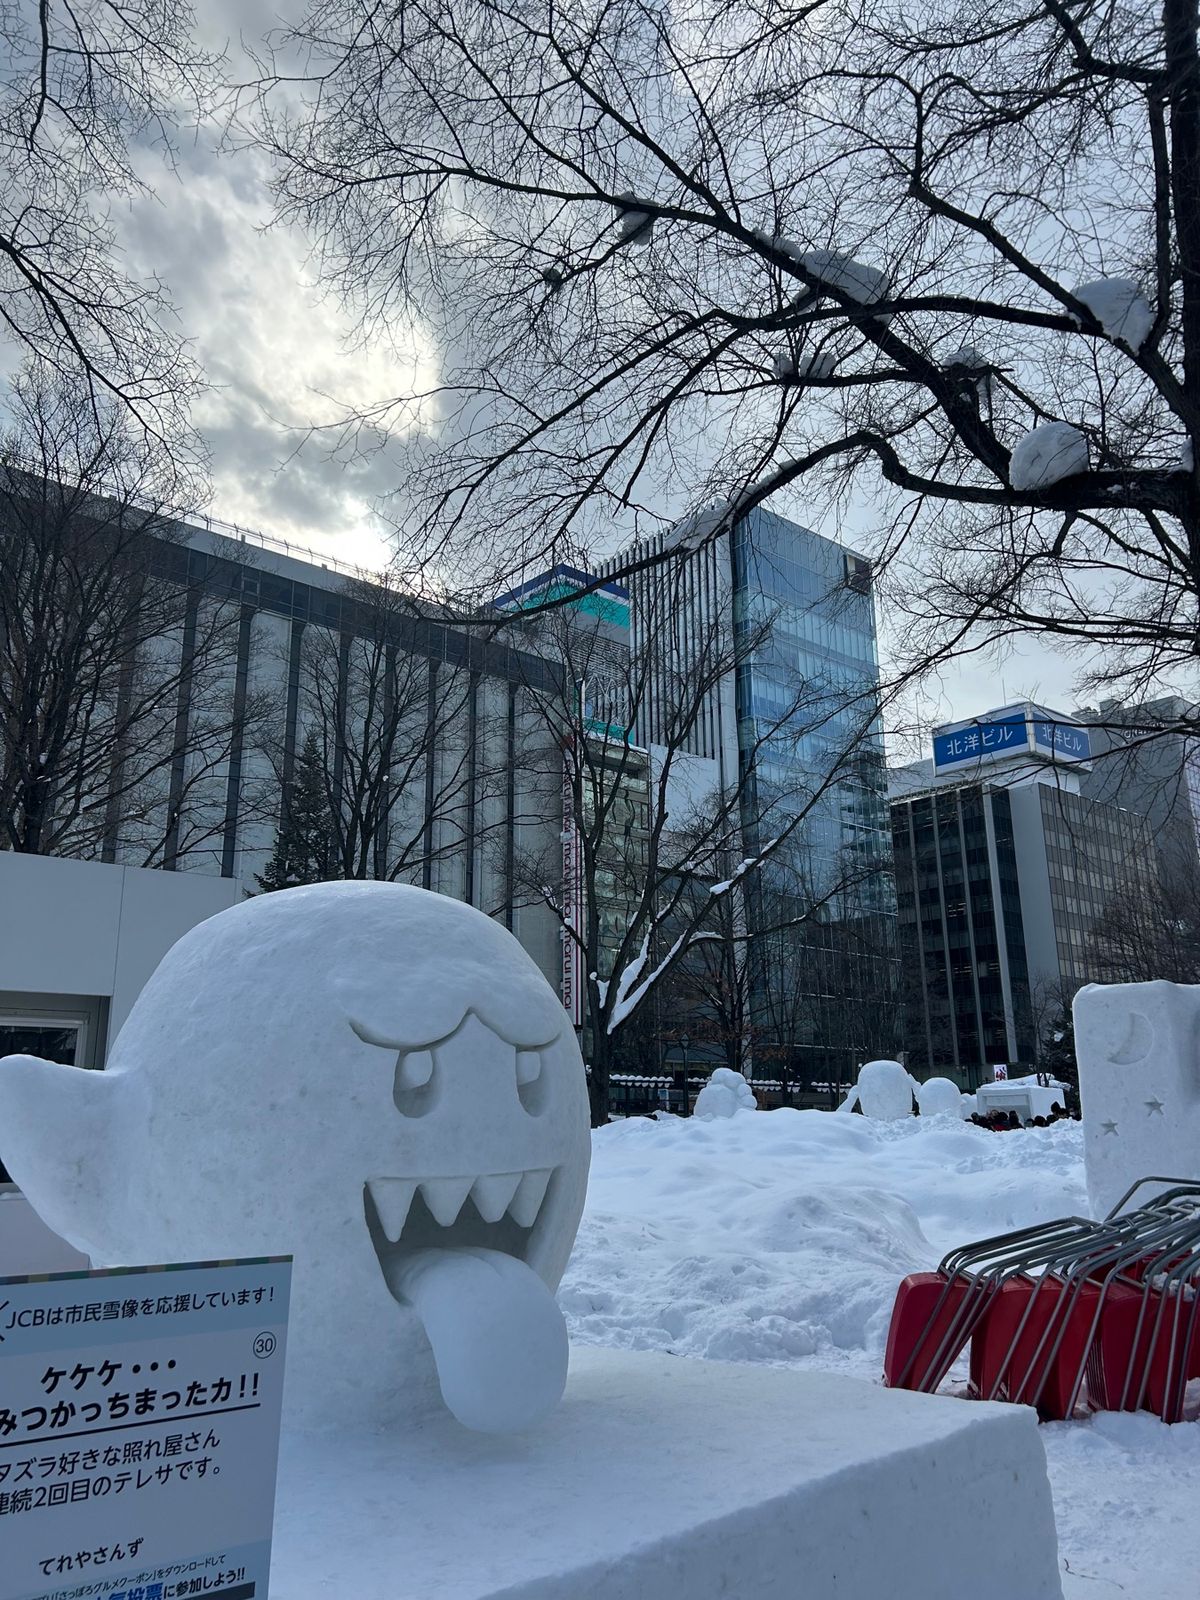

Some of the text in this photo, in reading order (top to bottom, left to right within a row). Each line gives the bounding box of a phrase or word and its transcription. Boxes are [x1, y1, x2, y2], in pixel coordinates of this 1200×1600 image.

[946, 726, 1013, 756] 北洋ビル
[1042, 724, 1082, 752] 北洋ビル
[564, 929, 572, 1010] marui imai
[38, 1537, 144, 1576] てれやさんず
